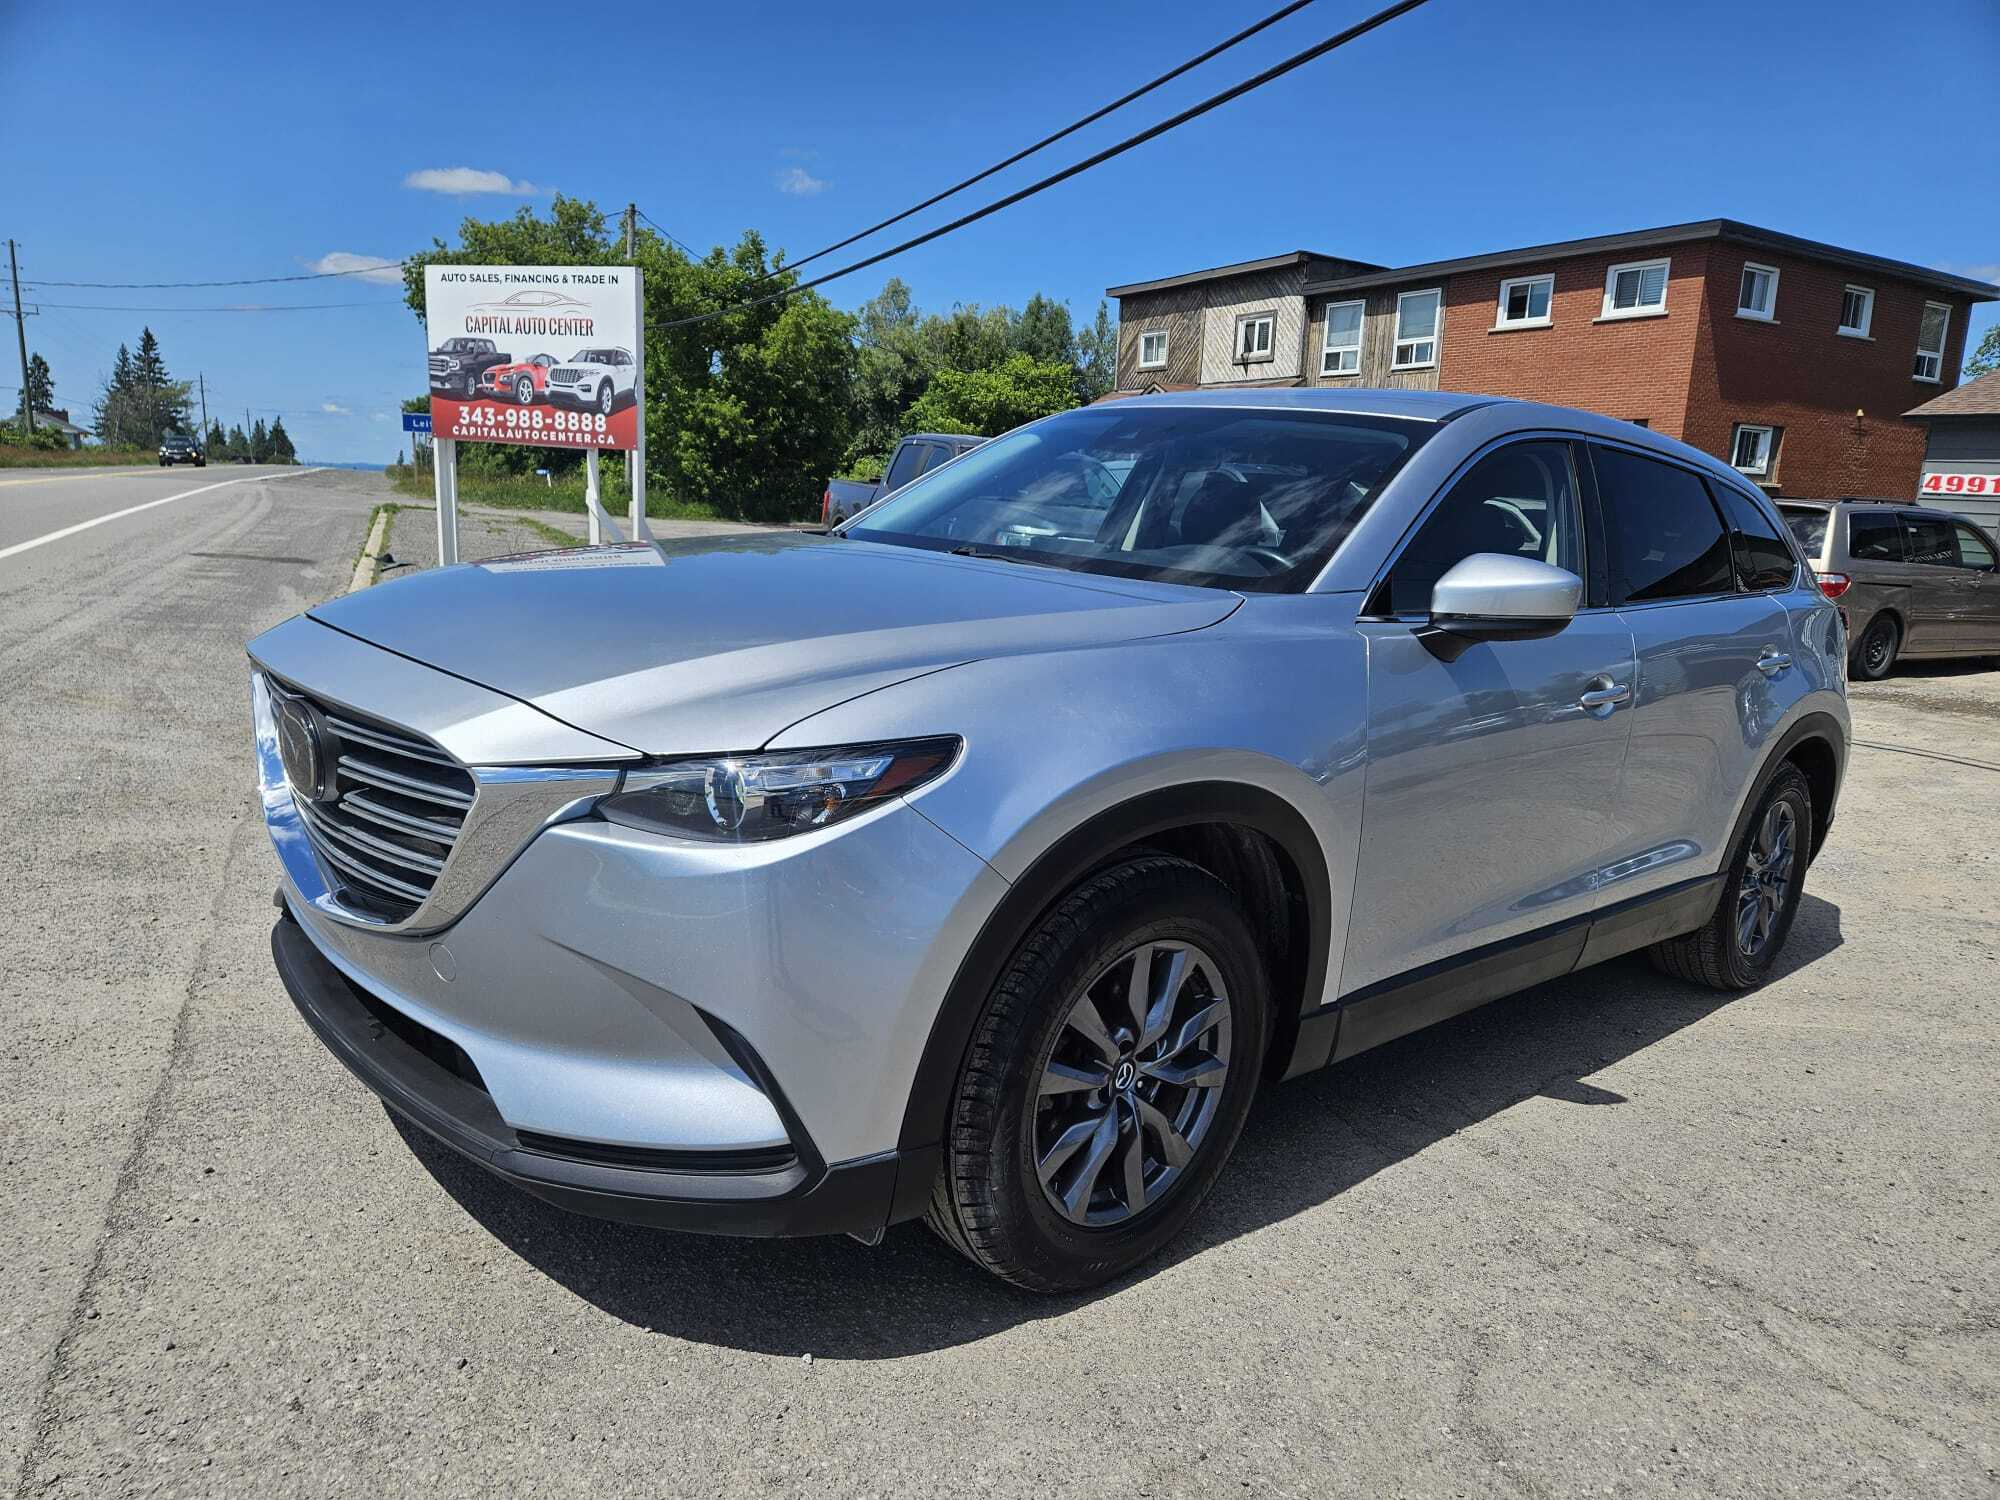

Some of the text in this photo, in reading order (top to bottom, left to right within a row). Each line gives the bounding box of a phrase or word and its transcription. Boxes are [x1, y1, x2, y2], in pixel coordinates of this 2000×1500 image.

[441, 273, 619, 285] AUTO SALES, FINANCING & TRADE IN
[465, 315, 594, 336] CAPITAL AUTO CENTER
[459, 405, 607, 432] 343-988-8888
[452, 425, 615, 445] CAPITALAUTOCENTER.CA
[1924, 475, 2000, 494] 4991
